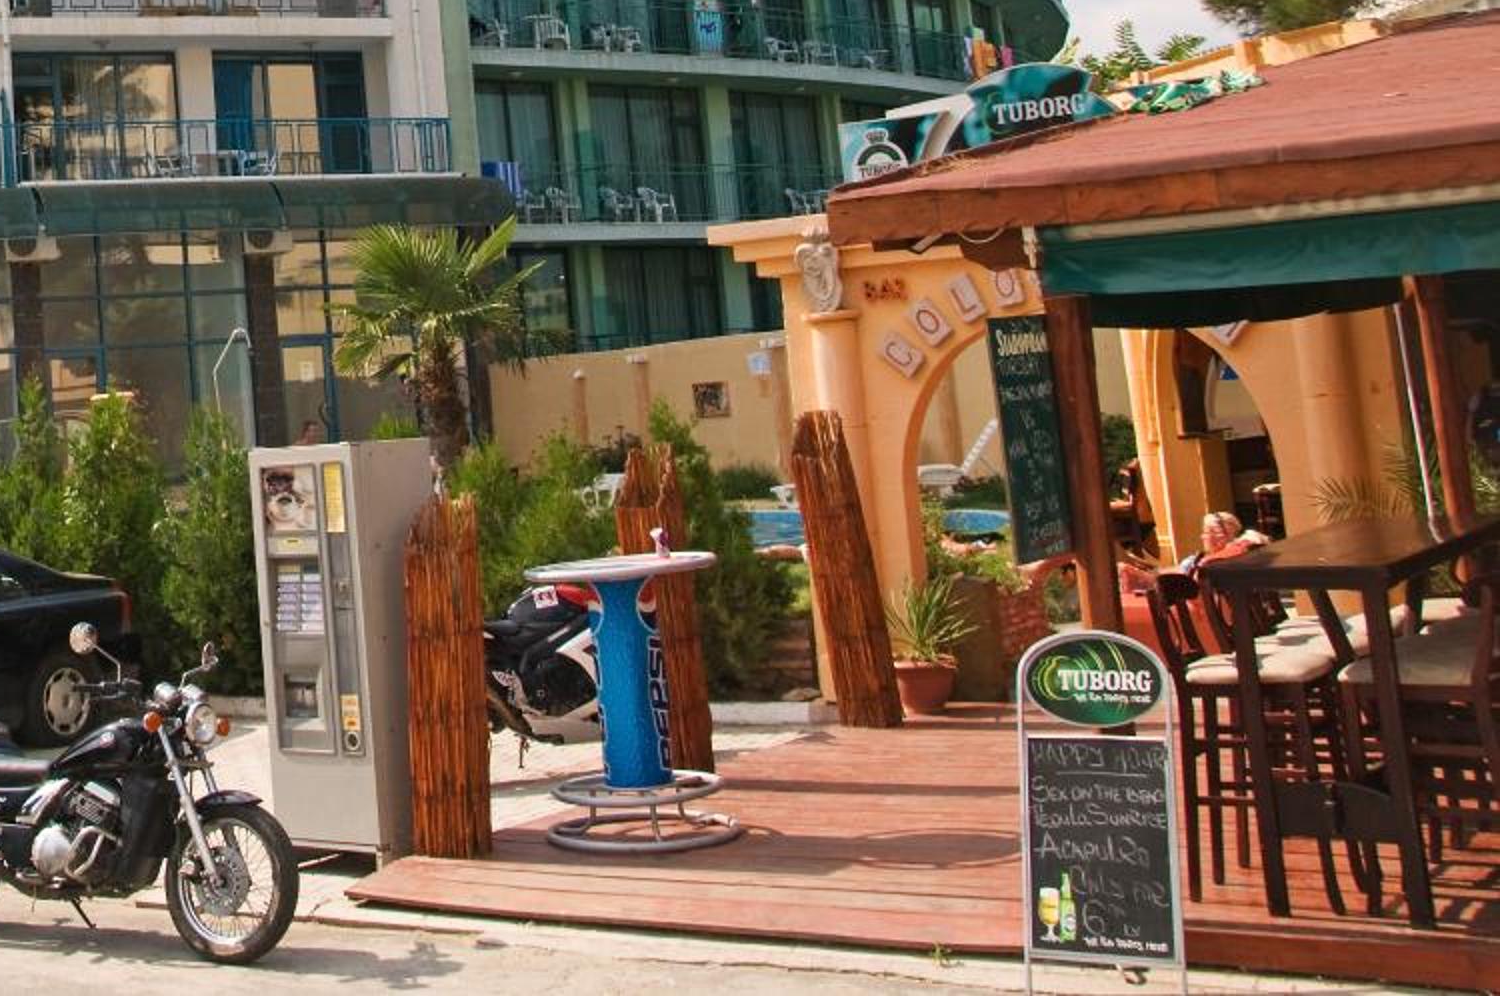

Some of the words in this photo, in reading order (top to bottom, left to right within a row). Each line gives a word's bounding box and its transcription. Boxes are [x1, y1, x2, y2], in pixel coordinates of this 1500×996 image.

[991, 93, 1085, 126] TUBORG
[1057, 669, 1153, 693] TUBORG
[1031, 742, 1105, 767] HAPPY
[1071, 786, 1092, 801] ON
[1093, 783, 1121, 802] THE
